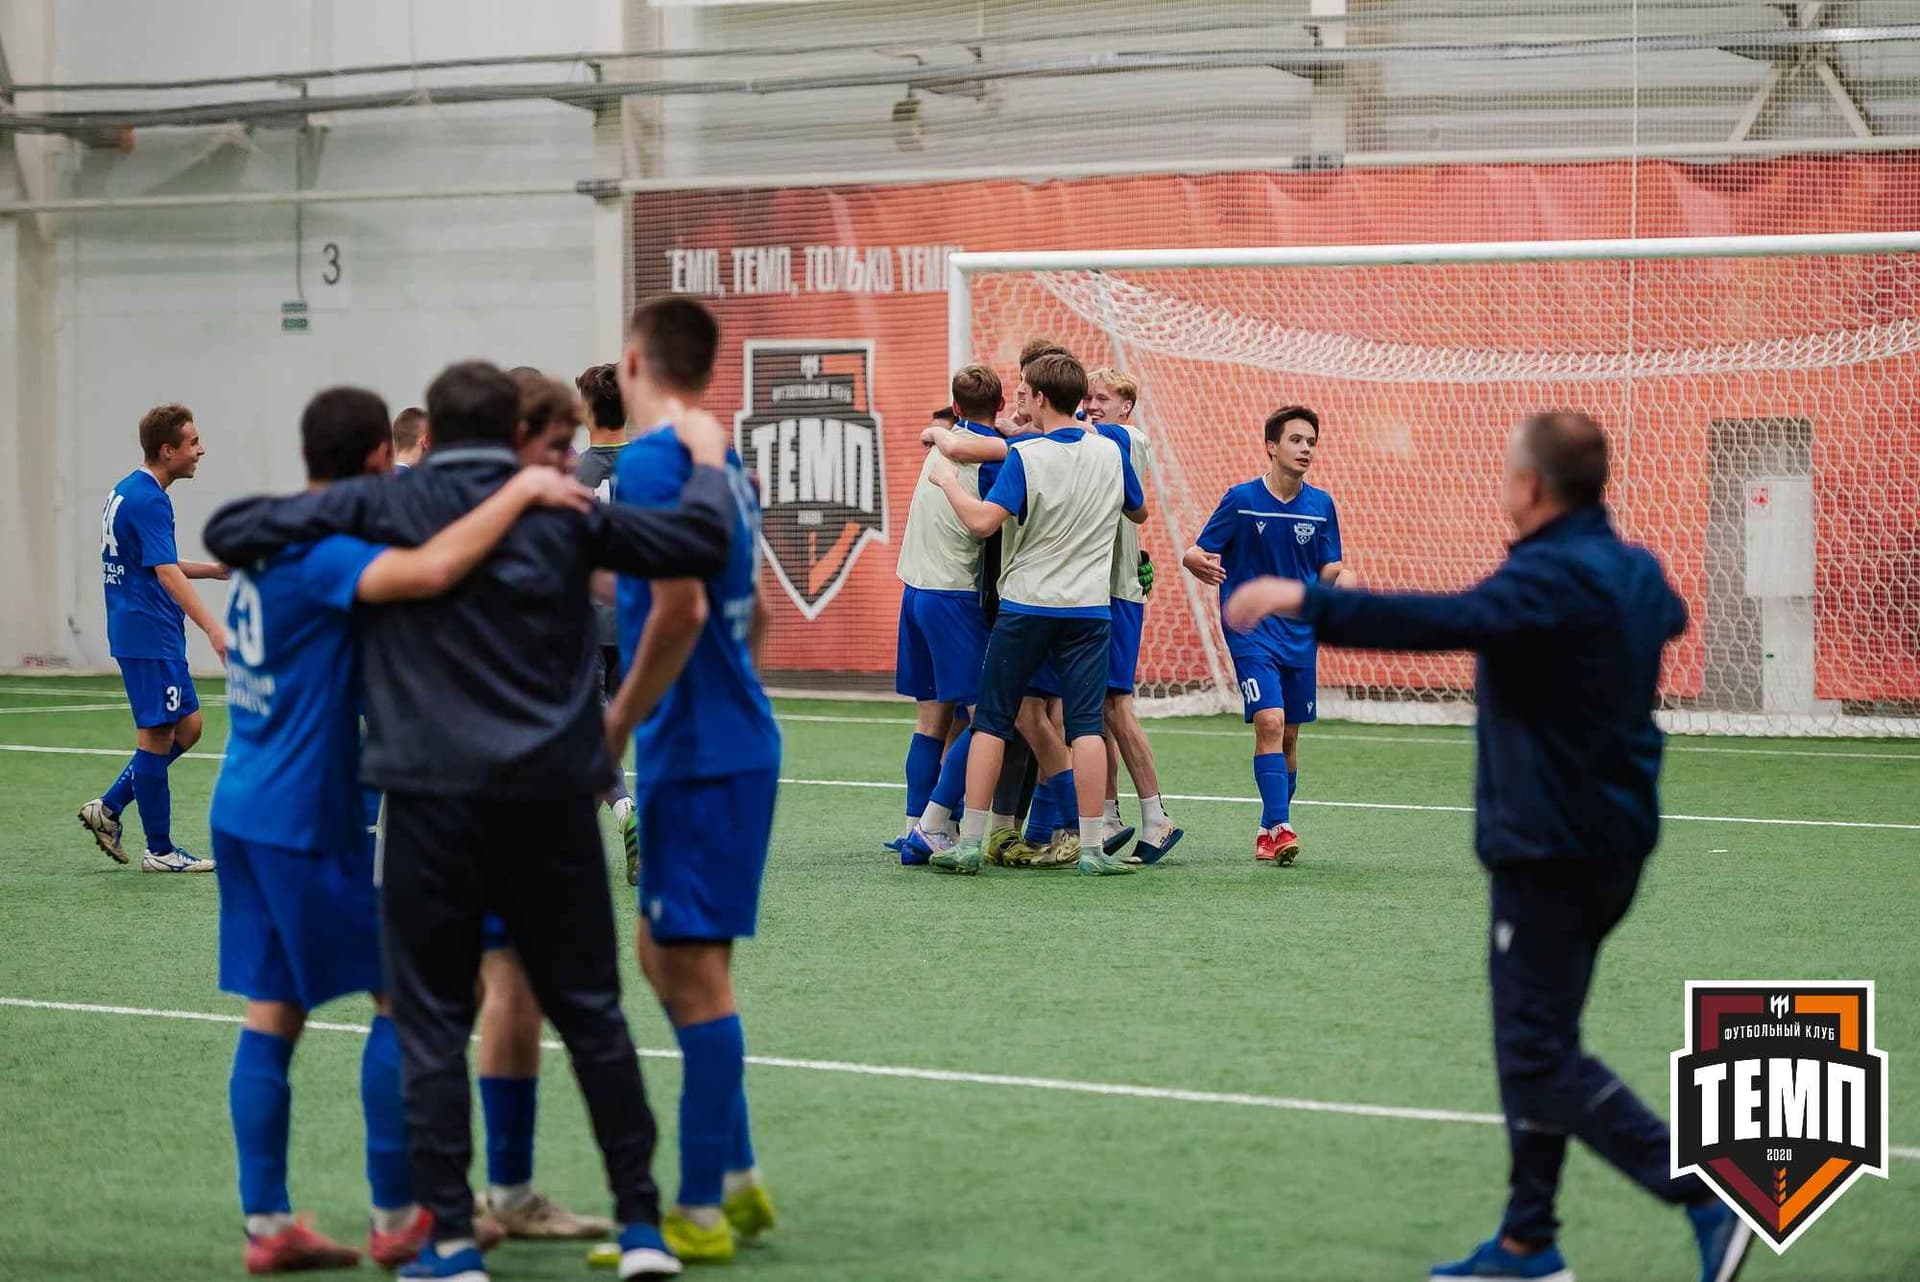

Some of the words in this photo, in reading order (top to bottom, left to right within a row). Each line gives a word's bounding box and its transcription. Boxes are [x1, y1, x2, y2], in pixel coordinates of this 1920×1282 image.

[322, 242, 341, 286] 3
[731, 246, 800, 298] ТЕМП,
[803, 246, 896, 293] ТОЛЬКО
[751, 417, 874, 514] ТЕМП
[166, 685, 182, 712] 3
[1240, 677, 1261, 704] 30
